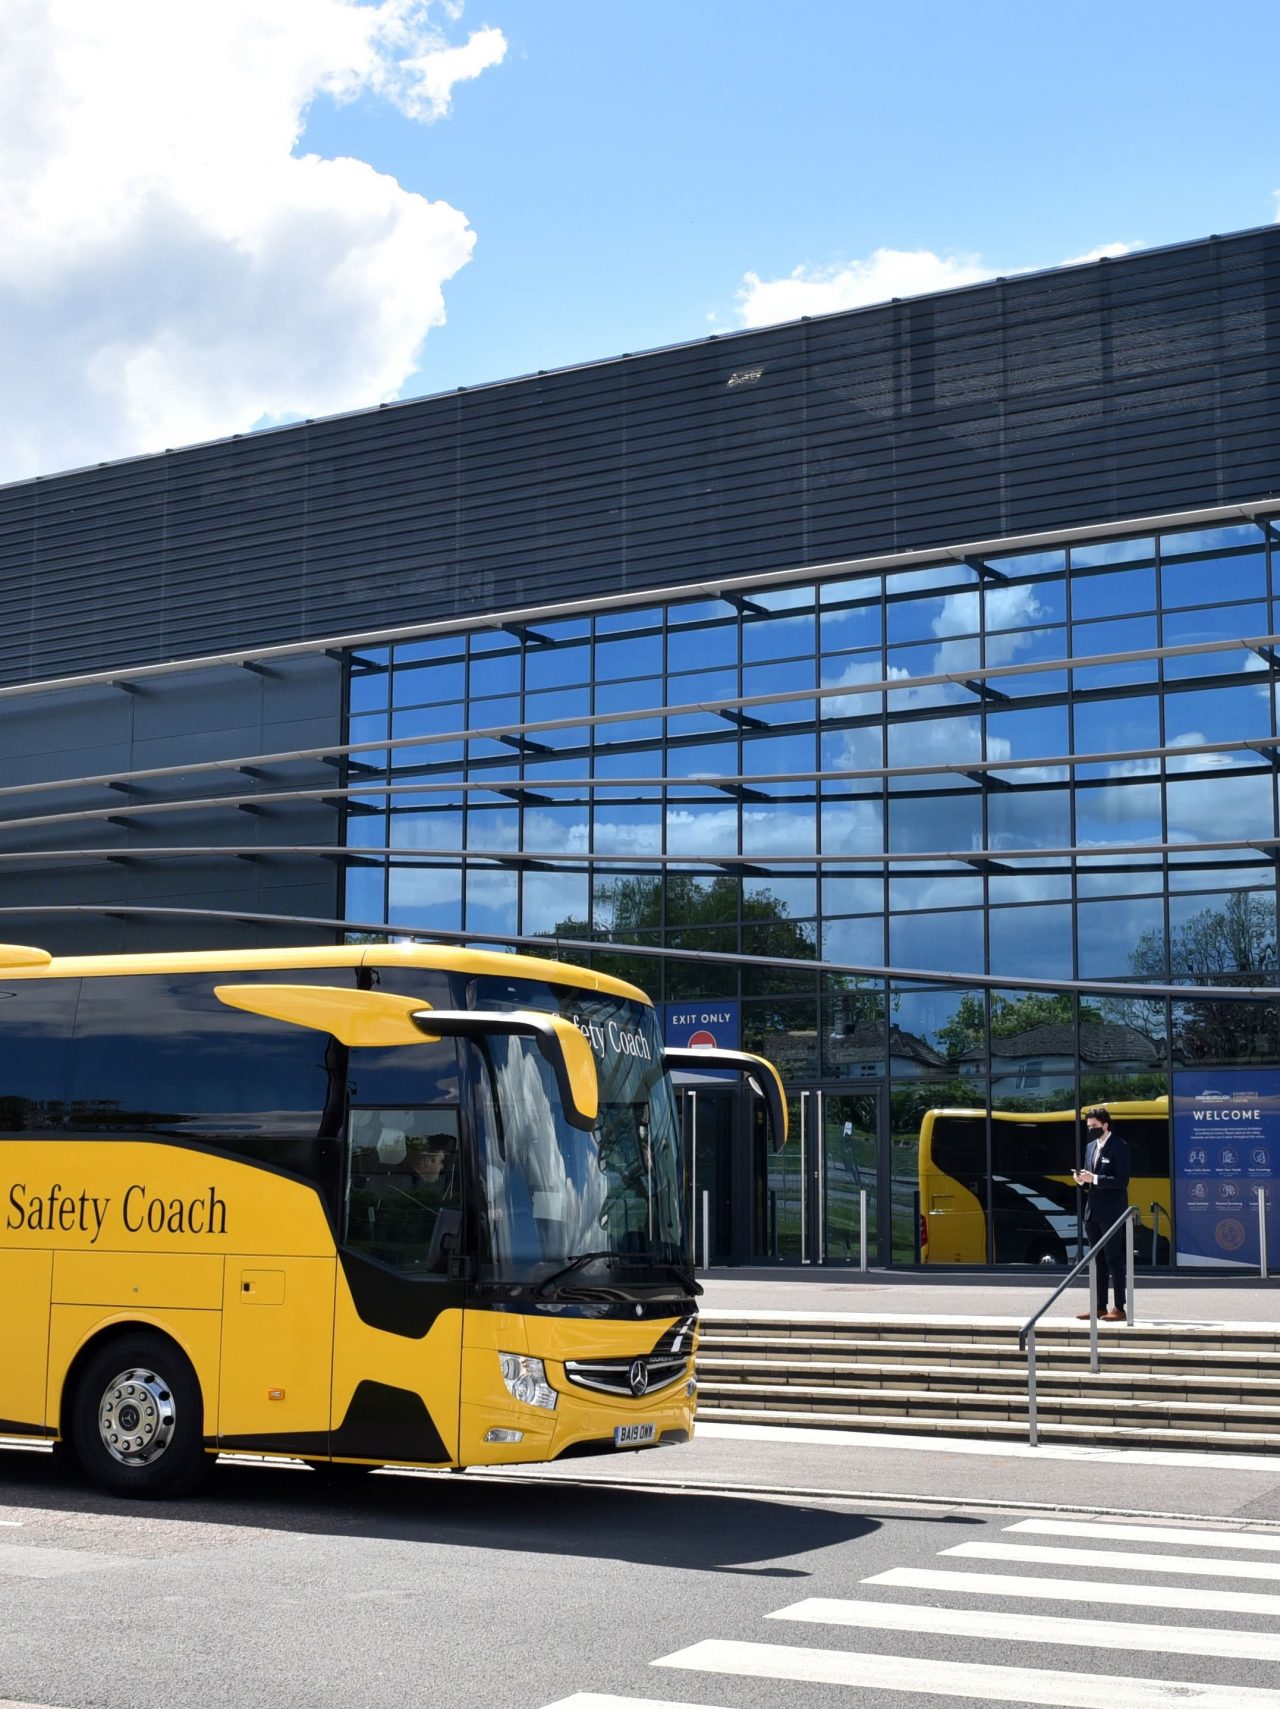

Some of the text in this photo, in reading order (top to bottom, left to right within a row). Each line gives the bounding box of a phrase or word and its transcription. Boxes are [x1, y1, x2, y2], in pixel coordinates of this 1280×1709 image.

[672, 1013, 732, 1025] EXIT ONLY
[608, 1021, 651, 1060] Coach
[1193, 1109, 1261, 1121] WELCOME
[6, 1183, 228, 1244] Safety Coach
[621, 1426, 639, 1442] BA19
